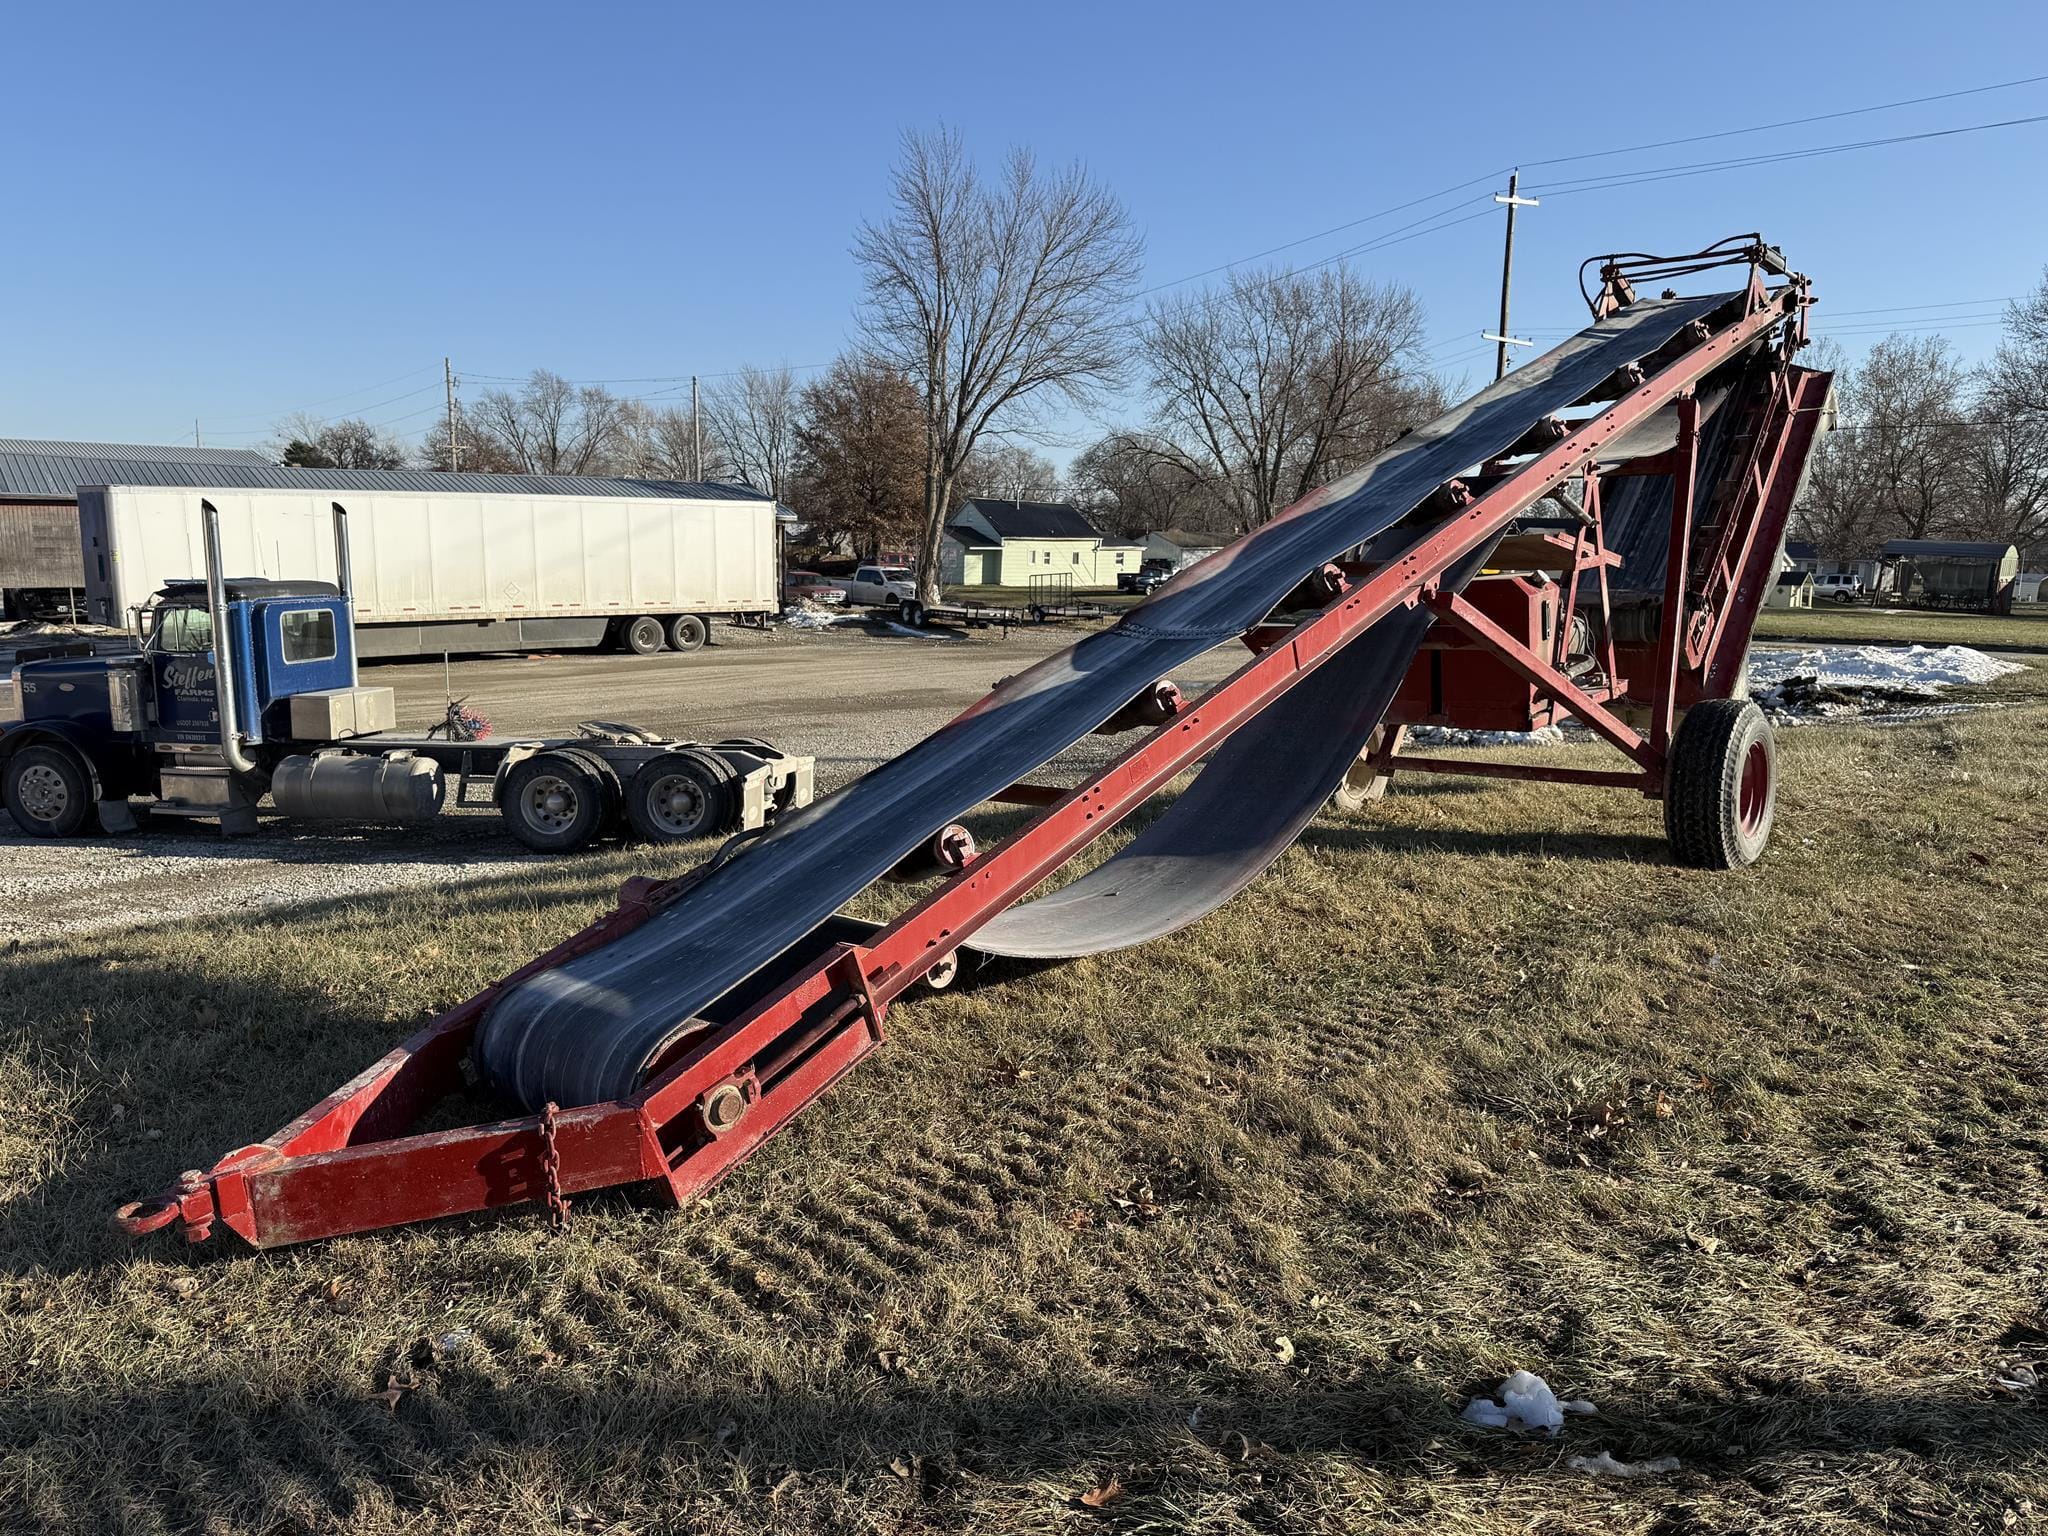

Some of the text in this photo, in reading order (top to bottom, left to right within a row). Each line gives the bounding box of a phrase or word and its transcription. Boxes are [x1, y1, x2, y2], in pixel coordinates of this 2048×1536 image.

[162, 665, 216, 689] Steffen
[23, 682, 37, 693] 55
[174, 688, 215, 697] FARMS
